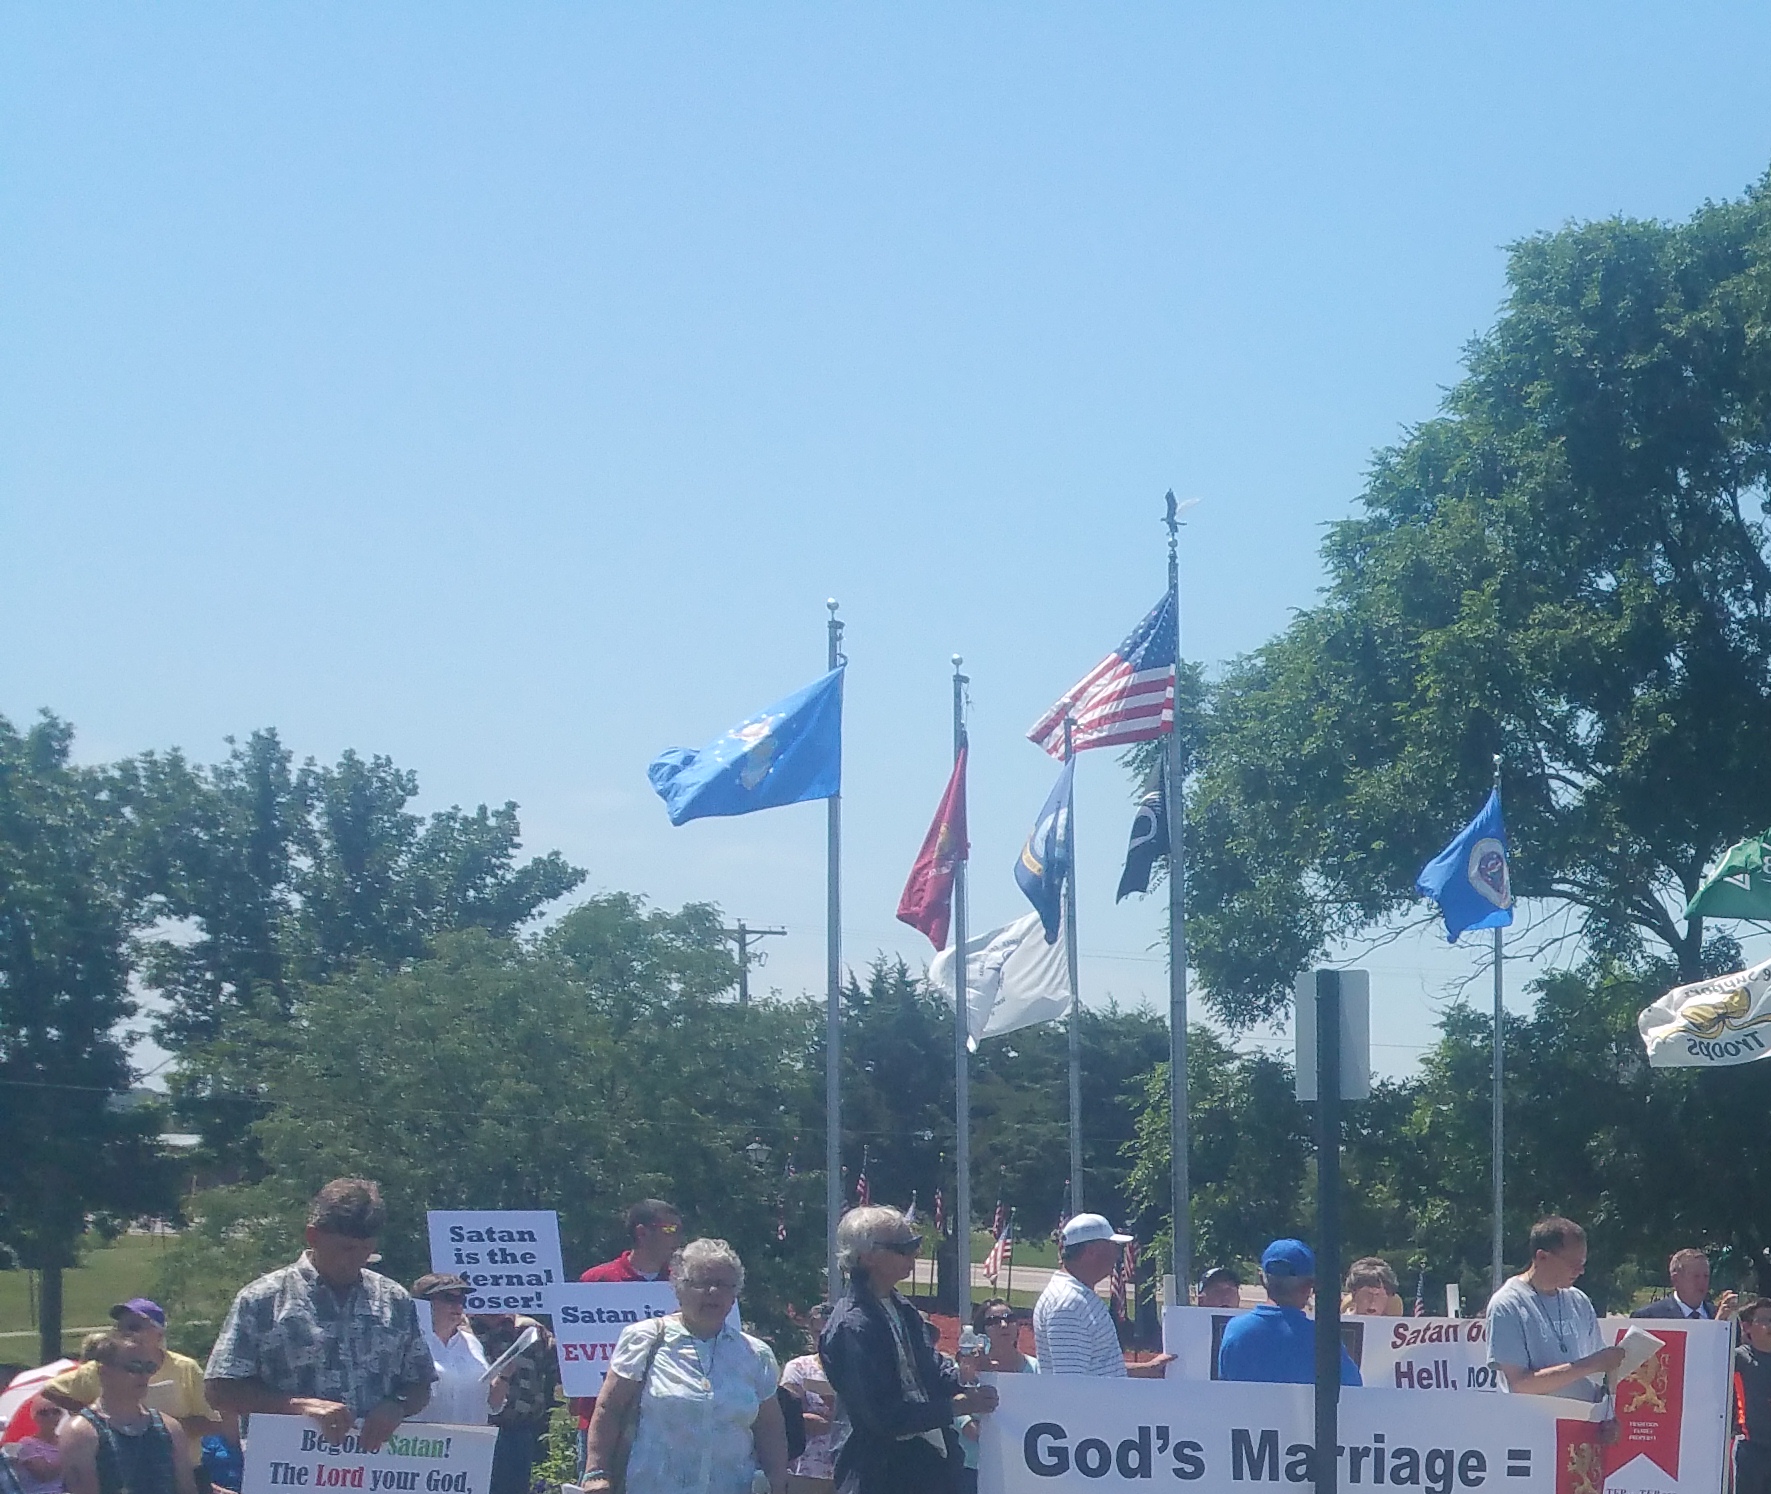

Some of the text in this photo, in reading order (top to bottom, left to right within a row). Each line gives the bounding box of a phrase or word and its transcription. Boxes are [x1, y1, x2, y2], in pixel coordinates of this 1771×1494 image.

[450, 1226, 537, 1243] Satan
[455, 1248, 537, 1265] is the
[460, 1269, 553, 1287] ternal
[463, 1291, 544, 1309] oser!
[562, 1304, 666, 1324] Satan is
[1391, 1321, 1459, 1349] Satan
[1394, 1360, 1458, 1390] Hell,
[387, 1434, 452, 1458] Satan!
[1023, 1422, 1206, 1480] God's
[1507, 1449, 1532, 1477] =
[270, 1461, 472, 1494] The Lord your God,
